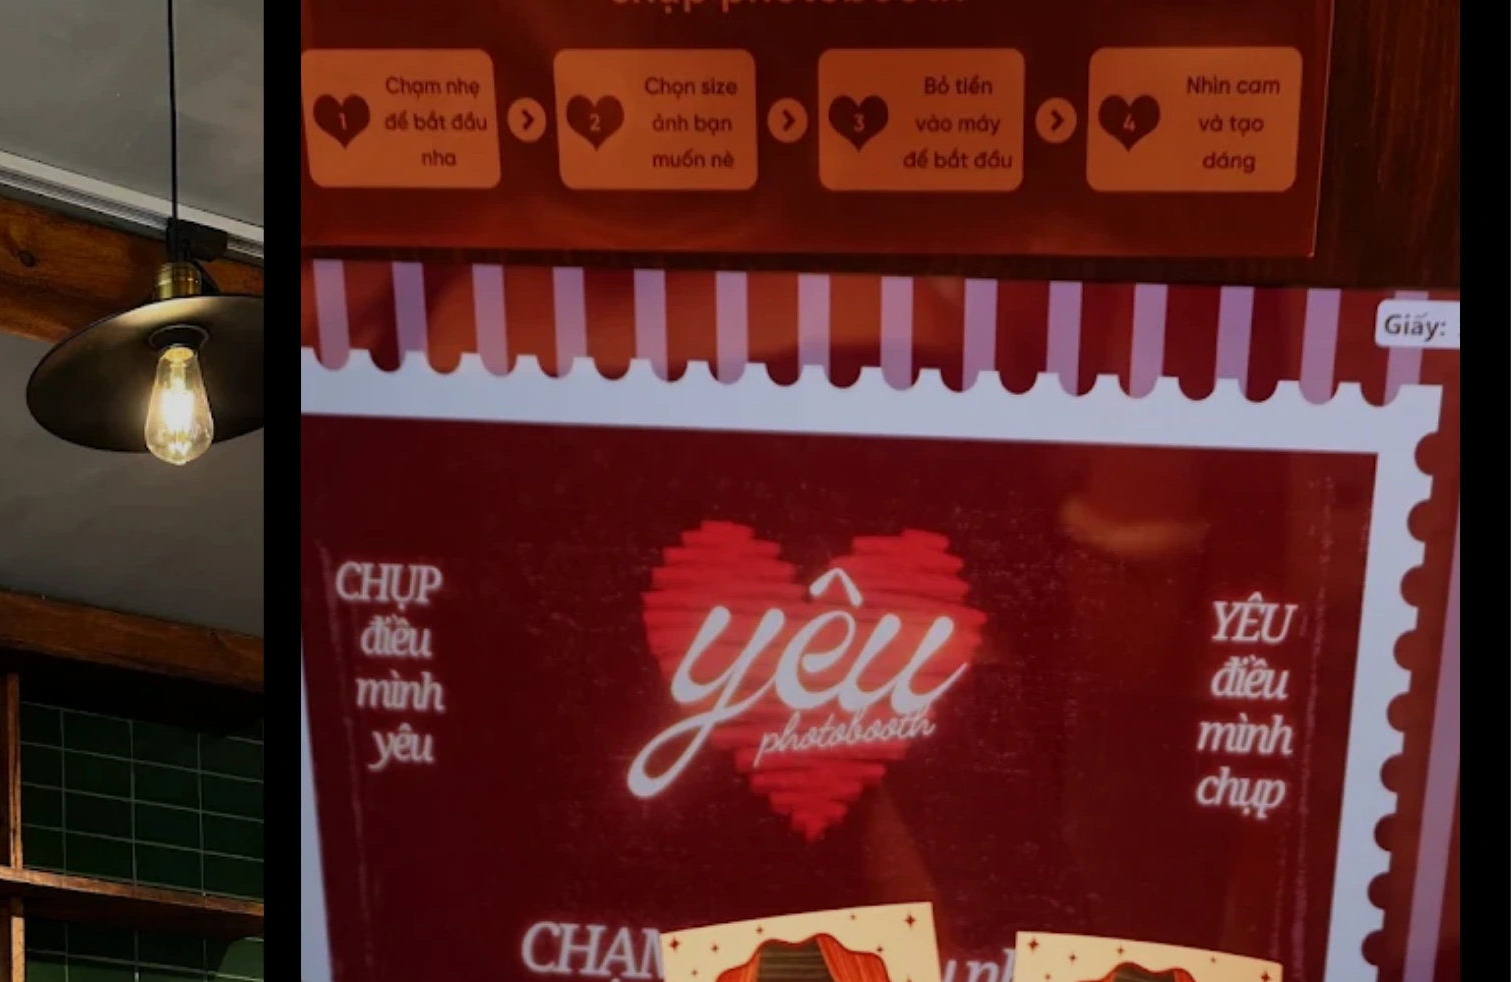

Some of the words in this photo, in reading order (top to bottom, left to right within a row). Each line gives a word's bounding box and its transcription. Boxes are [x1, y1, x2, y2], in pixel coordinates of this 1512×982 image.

[385, 76, 441, 97] Chạm
[446, 76, 480, 97] nhẹ
[643, 76, 695, 97] Chọn
[701, 77, 738, 96] size
[924, 74, 949, 95] Bỏ
[1186, 74, 1230, 96] Nhìn
[1236, 78, 1280, 96] cam
[338, 113, 347, 131] 1
[590, 113, 601, 131] 2
[653, 112, 690, 133] ảnh
[694, 113, 732, 135] bạn
[852, 114, 865, 132] 3
[915, 114, 953, 134] vào
[958, 114, 1001, 139] máy
[1122, 113, 1135, 132] 4
[1198, 114, 1223, 134] và
[1229, 115, 1264, 138] tạo
[421, 148, 456, 167] nha
[652, 150, 706, 169] muốn
[711, 151, 734, 169] nè
[1202, 150, 1255, 175] dáng
[1384, 312, 1447, 342] Giấy:
[335, 560, 443, 612] CHỤP
[1211, 590, 1299, 644] YÊU
[360, 613, 434, 659] điều
[627, 567, 968, 798] yêu
[1210, 654, 1290, 700] điều
[355, 668, 446, 714] mình
[752, 706, 936, 768] photobooth
[1196, 712, 1294, 757] mình
[368, 722, 435, 773] yêu
[1195, 766, 1287, 820] chụp
